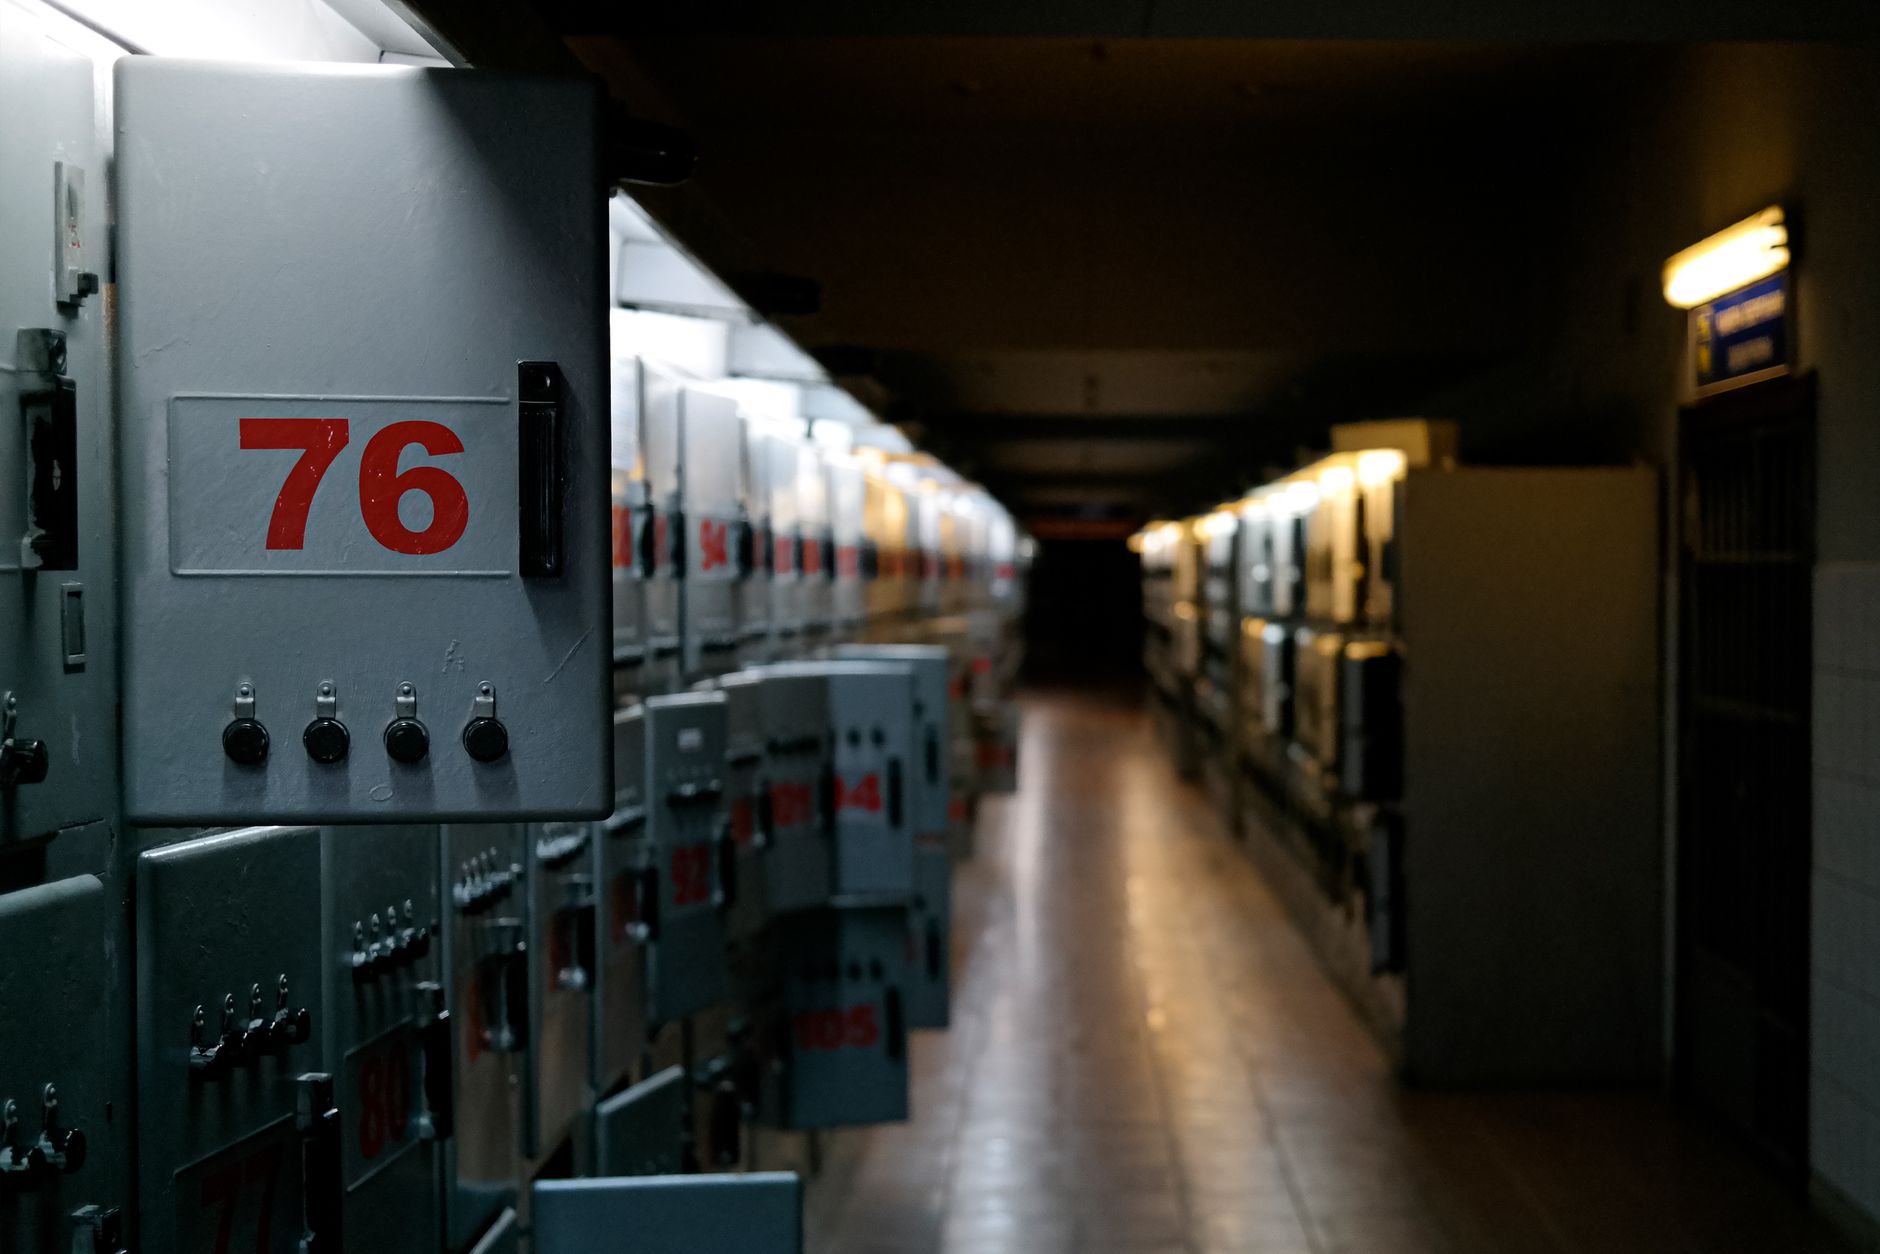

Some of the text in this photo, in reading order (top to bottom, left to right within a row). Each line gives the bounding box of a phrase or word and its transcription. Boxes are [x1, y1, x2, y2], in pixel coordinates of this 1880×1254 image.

[240, 419, 467, 554] 76
[361, 1044, 410, 1158] 80
[202, 1146, 281, 1254] 77
